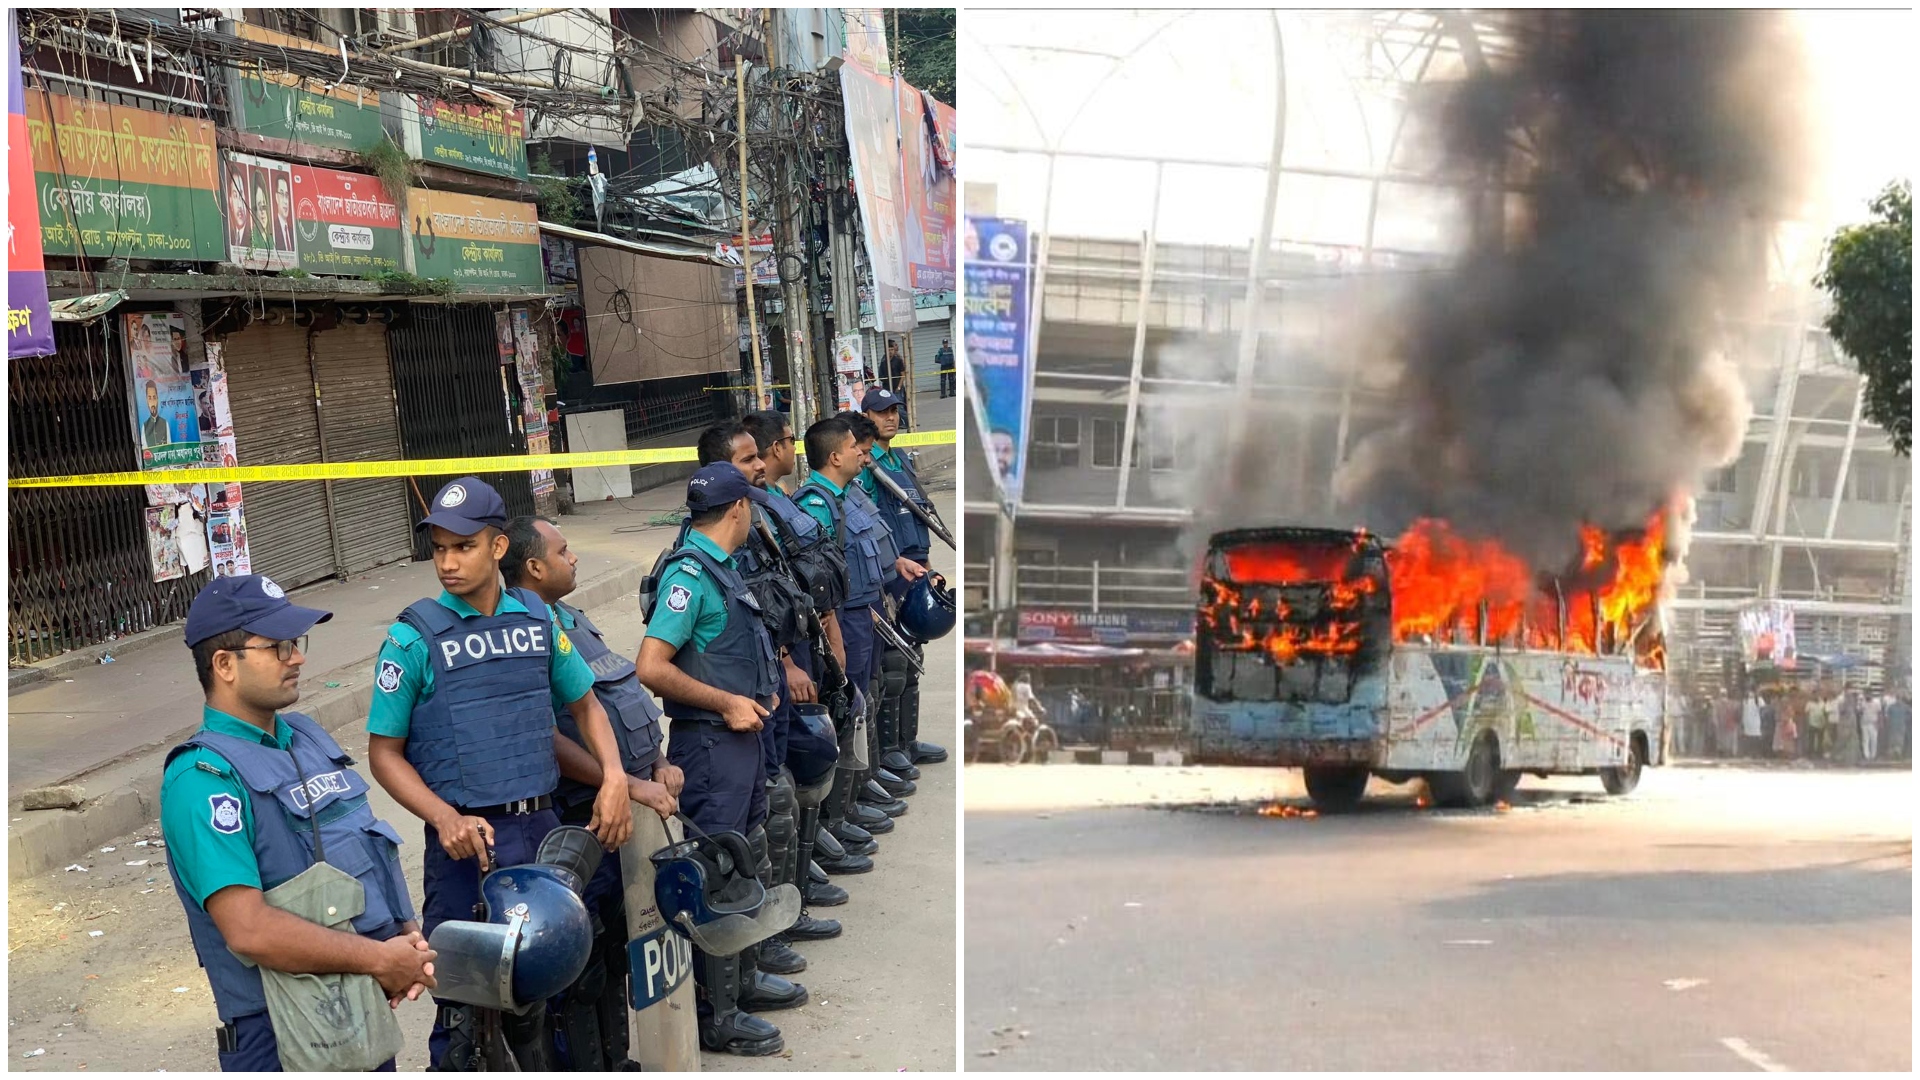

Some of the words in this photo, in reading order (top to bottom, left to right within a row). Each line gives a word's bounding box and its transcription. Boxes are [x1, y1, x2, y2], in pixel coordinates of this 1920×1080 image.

[316, 194, 344, 216] বাংলাদেশ
[344, 192, 379, 219] জাতীয়তাবাদী
[433, 212, 466, 234] বাংলাদেশ
[466, 210, 508, 237] জাতীয়তাবাদী
[1021, 612, 1072, 625] SONY
[1073, 614, 1127, 626] SAMSUNG
[441, 626, 545, 667] POLICE
[300, 775, 340, 803] POLICE
